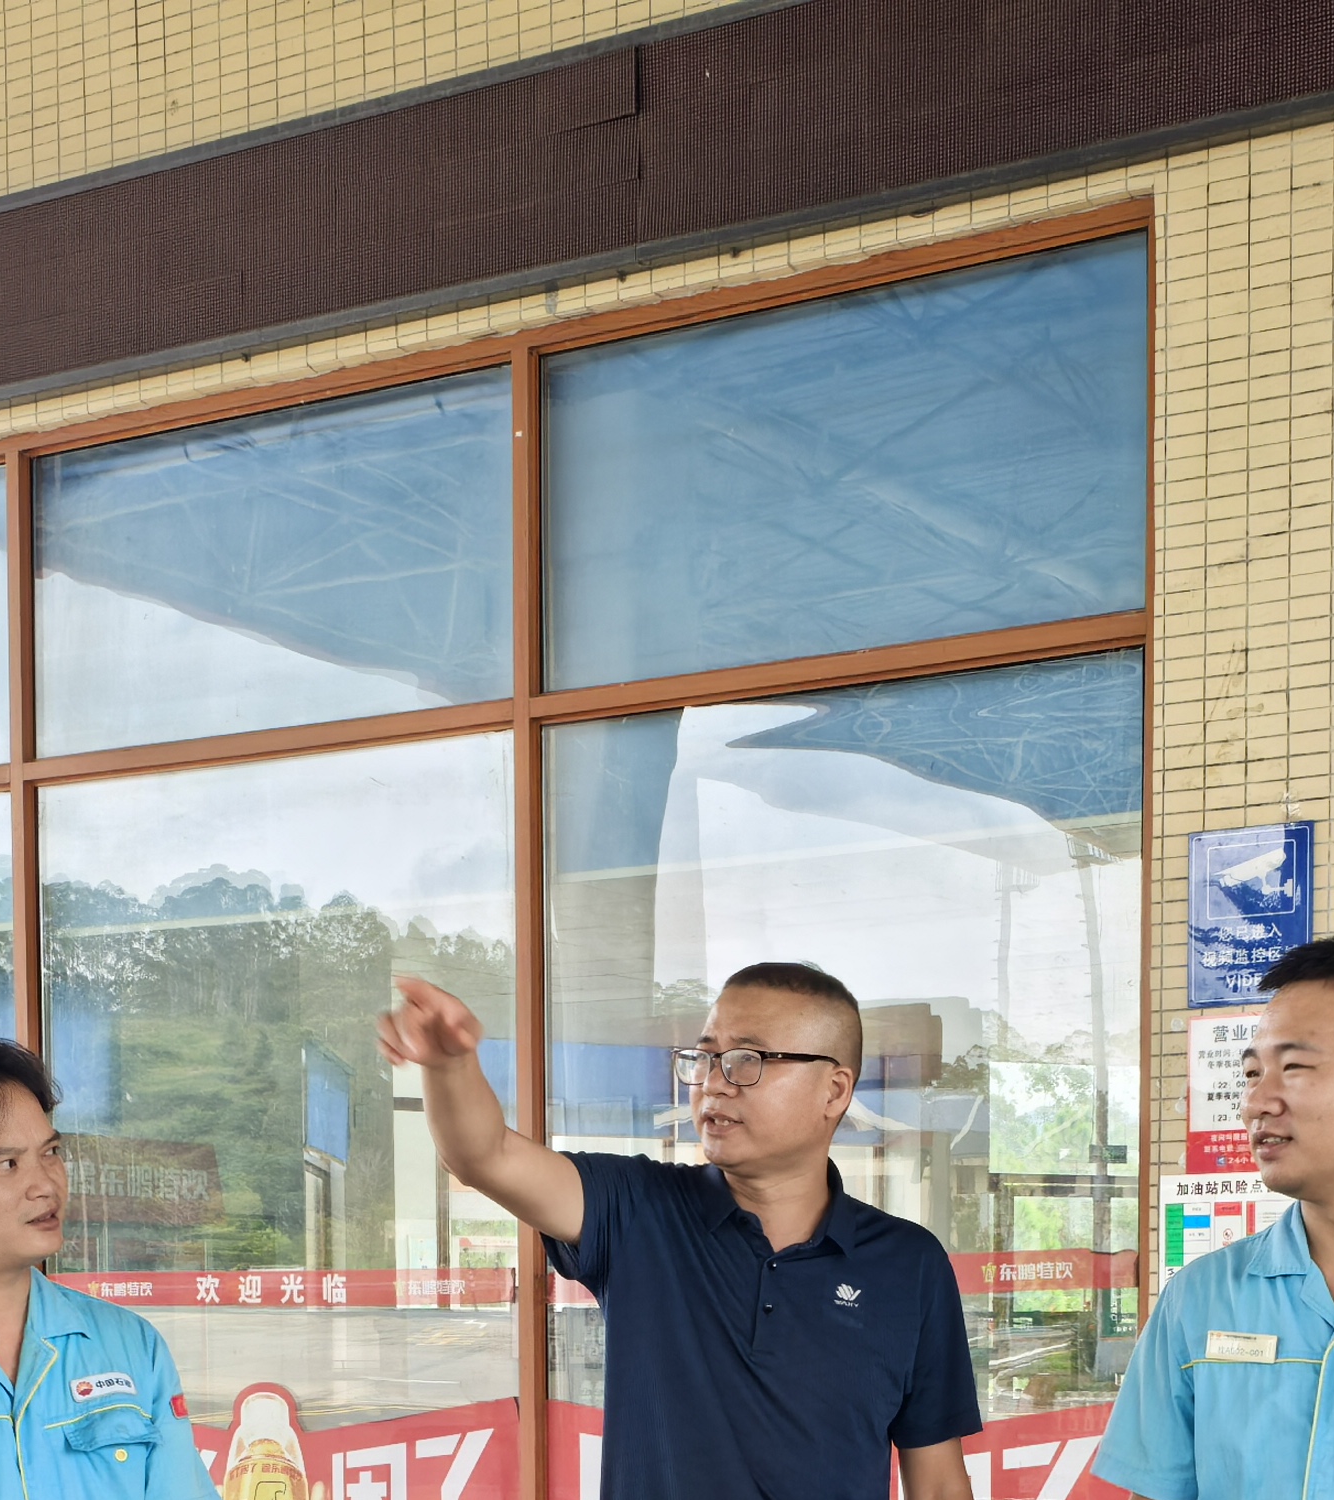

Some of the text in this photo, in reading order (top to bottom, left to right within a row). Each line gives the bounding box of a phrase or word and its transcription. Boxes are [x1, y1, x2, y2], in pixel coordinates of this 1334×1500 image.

[1201, 945, 1298, 966] 视频监控区
[1176, 1180, 1272, 1196] 加油站风险点
[999, 1261, 1073, 1281] 东鹏特饮
[195, 1274, 348, 1305] 欢迎光临
[95, 1377, 133, 1389] 中国石油
